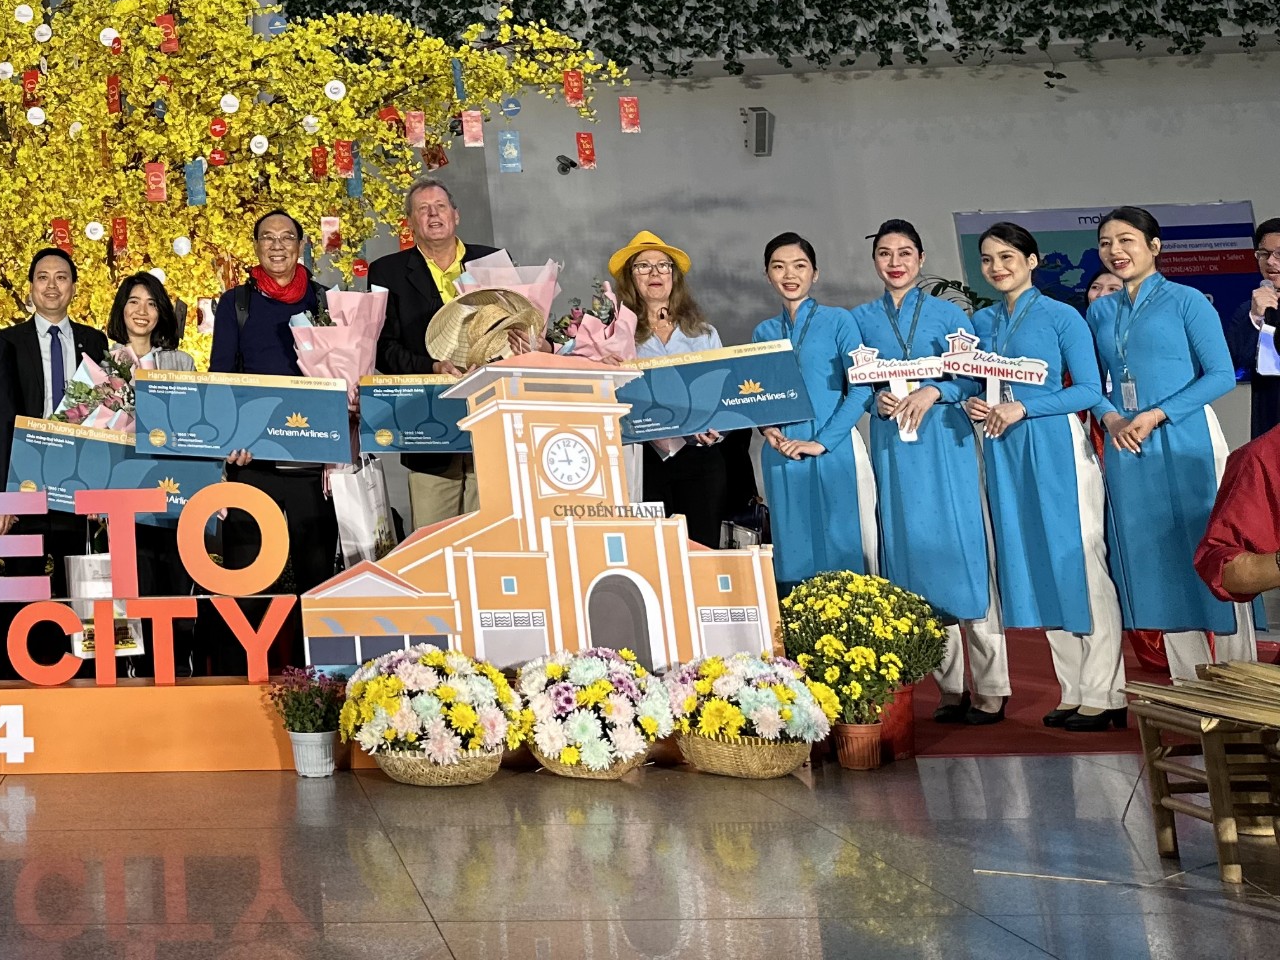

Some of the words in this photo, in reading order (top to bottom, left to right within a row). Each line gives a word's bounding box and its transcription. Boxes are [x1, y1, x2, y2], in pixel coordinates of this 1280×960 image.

[973, 351, 1025, 367] Vibrant
[850, 372, 867, 381] HO
[869, 371, 887, 380] CHI
[888, 369, 916, 379] MINH
[916, 367, 943, 377] CITY
[943, 360, 960, 371] HO
[962, 362, 982, 375] CHI
[983, 364, 1014, 378] MINH
[1014, 369, 1044, 383] CITY
[722, 395, 756, 407] Vietnam
[756, 391, 786, 403] Airlines
[266, 427, 300, 438] Vietnam
[300, 429, 329, 439] Airlines
[563, 440, 571, 448] 12
[548, 457, 555, 465] 9
[581, 456, 588, 464] 3
[567, 474, 573, 482] 6
[553, 503, 586, 519] CHỢ
[587, 501, 615, 518] BẾN
[615, 502, 665, 519] THÀNH
[75, 481, 289, 598] TO
[7, 595, 297, 687] CITY
